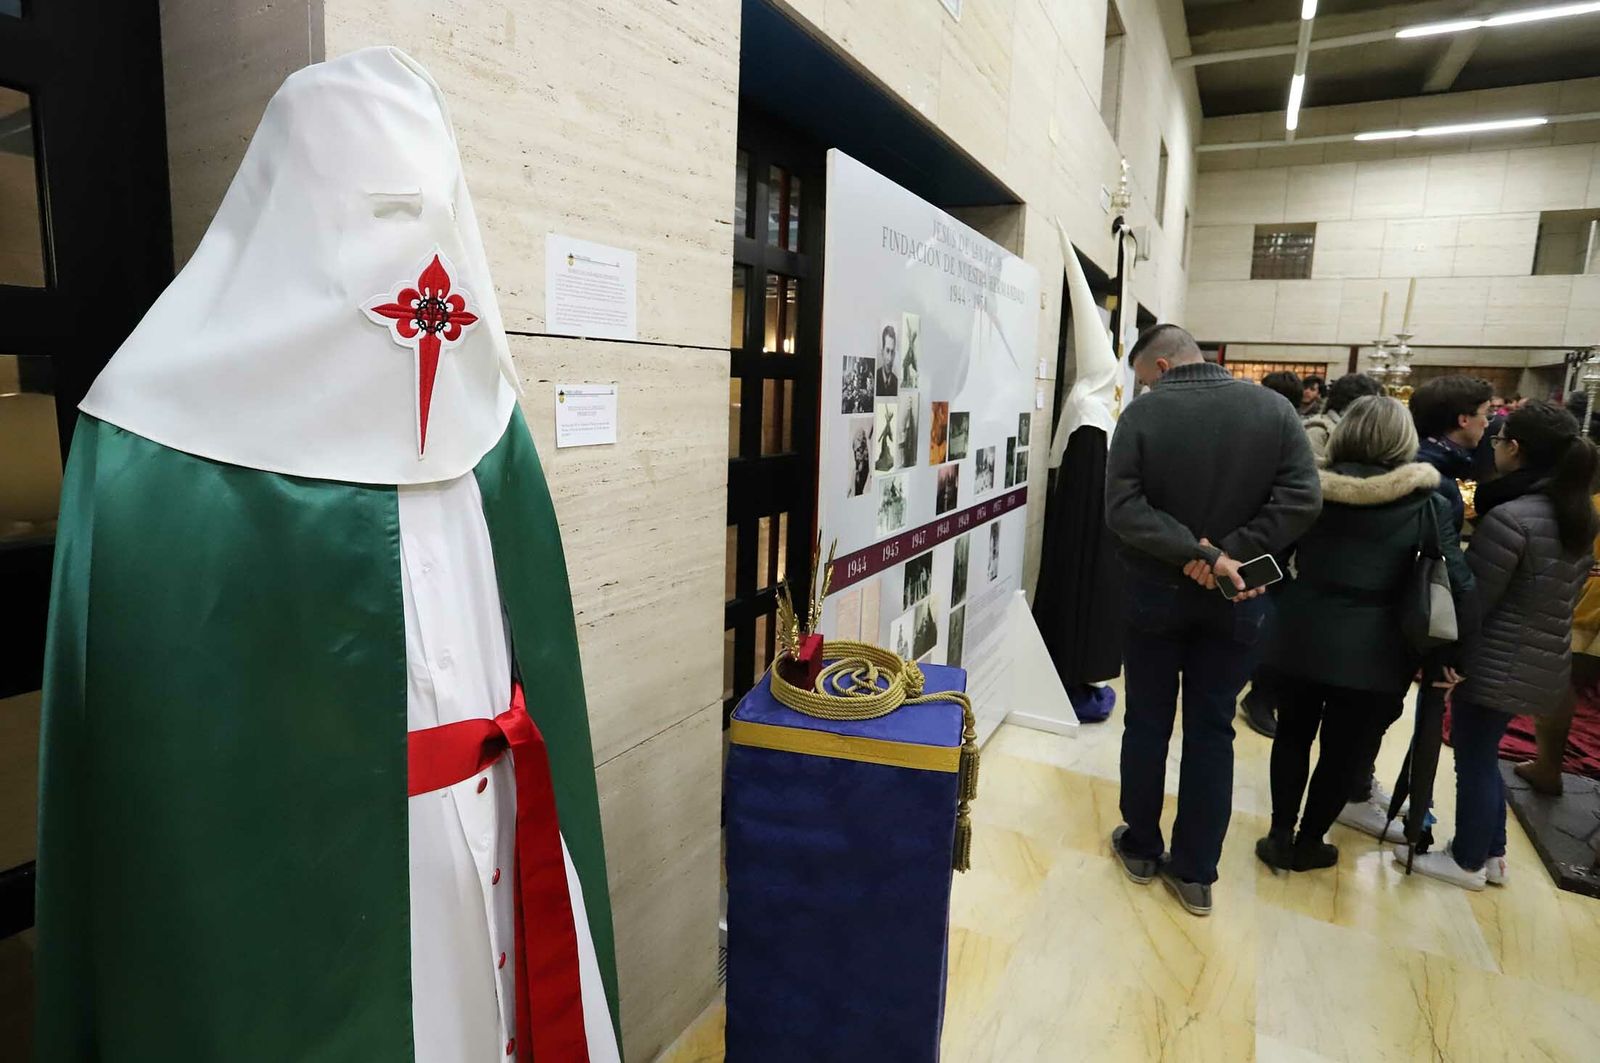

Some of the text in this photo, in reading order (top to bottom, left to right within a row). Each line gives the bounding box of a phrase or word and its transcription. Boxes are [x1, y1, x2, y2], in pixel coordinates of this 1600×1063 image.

[847, 555, 867, 578] 1944
[882, 541, 900, 562] 1945
[911, 530, 927, 549] 1947
